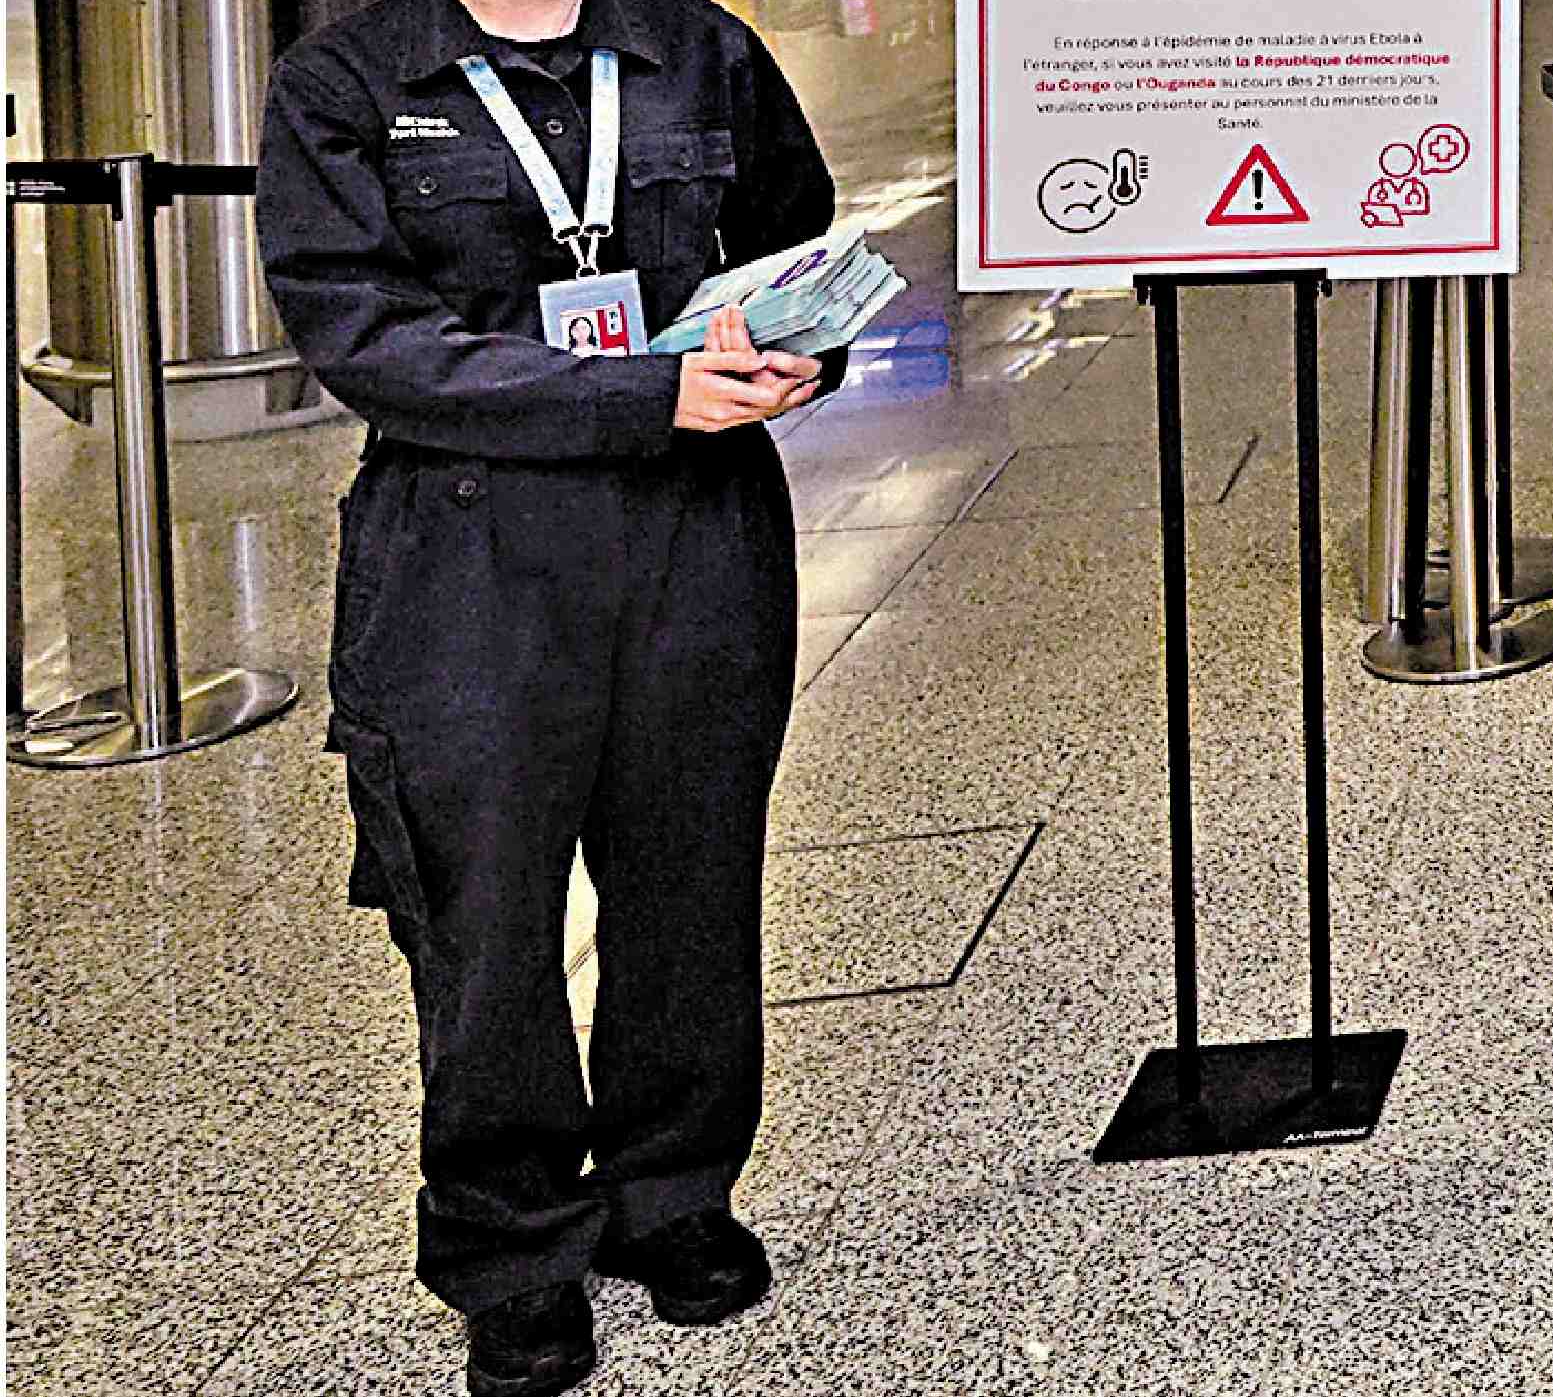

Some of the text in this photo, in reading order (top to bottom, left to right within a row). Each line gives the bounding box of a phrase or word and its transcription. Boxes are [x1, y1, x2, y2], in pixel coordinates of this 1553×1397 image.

[1054, 36, 1073, 48] En
[1235, 35, 1254, 47] de
[1257, 34, 1316, 46] maladie
[1331, 34, 1366, 45] virus
[1369, 33, 1410, 45] Ebola
[1118, 58, 1152, 69] vous
[1236, 55, 1249, 67] la
[1254, 54, 1341, 69] République
[1345, 54, 1450, 68] démocratique
[1034, 79, 1056, 91] du
[1058, 78, 1111, 93] Congo
[1114, 81, 1133, 91] ou
[1240, 77, 1282, 88] cours
[1287, 75, 1312, 87] des
[1316, 75, 1333, 86] 21
[1338, 75, 1397, 87] derniers
[1098, 102, 1133, 112] vous
[1310, 96, 1329, 107] du
[1402, 94, 1421, 105] de
[1424, 94, 1438, 105] la
